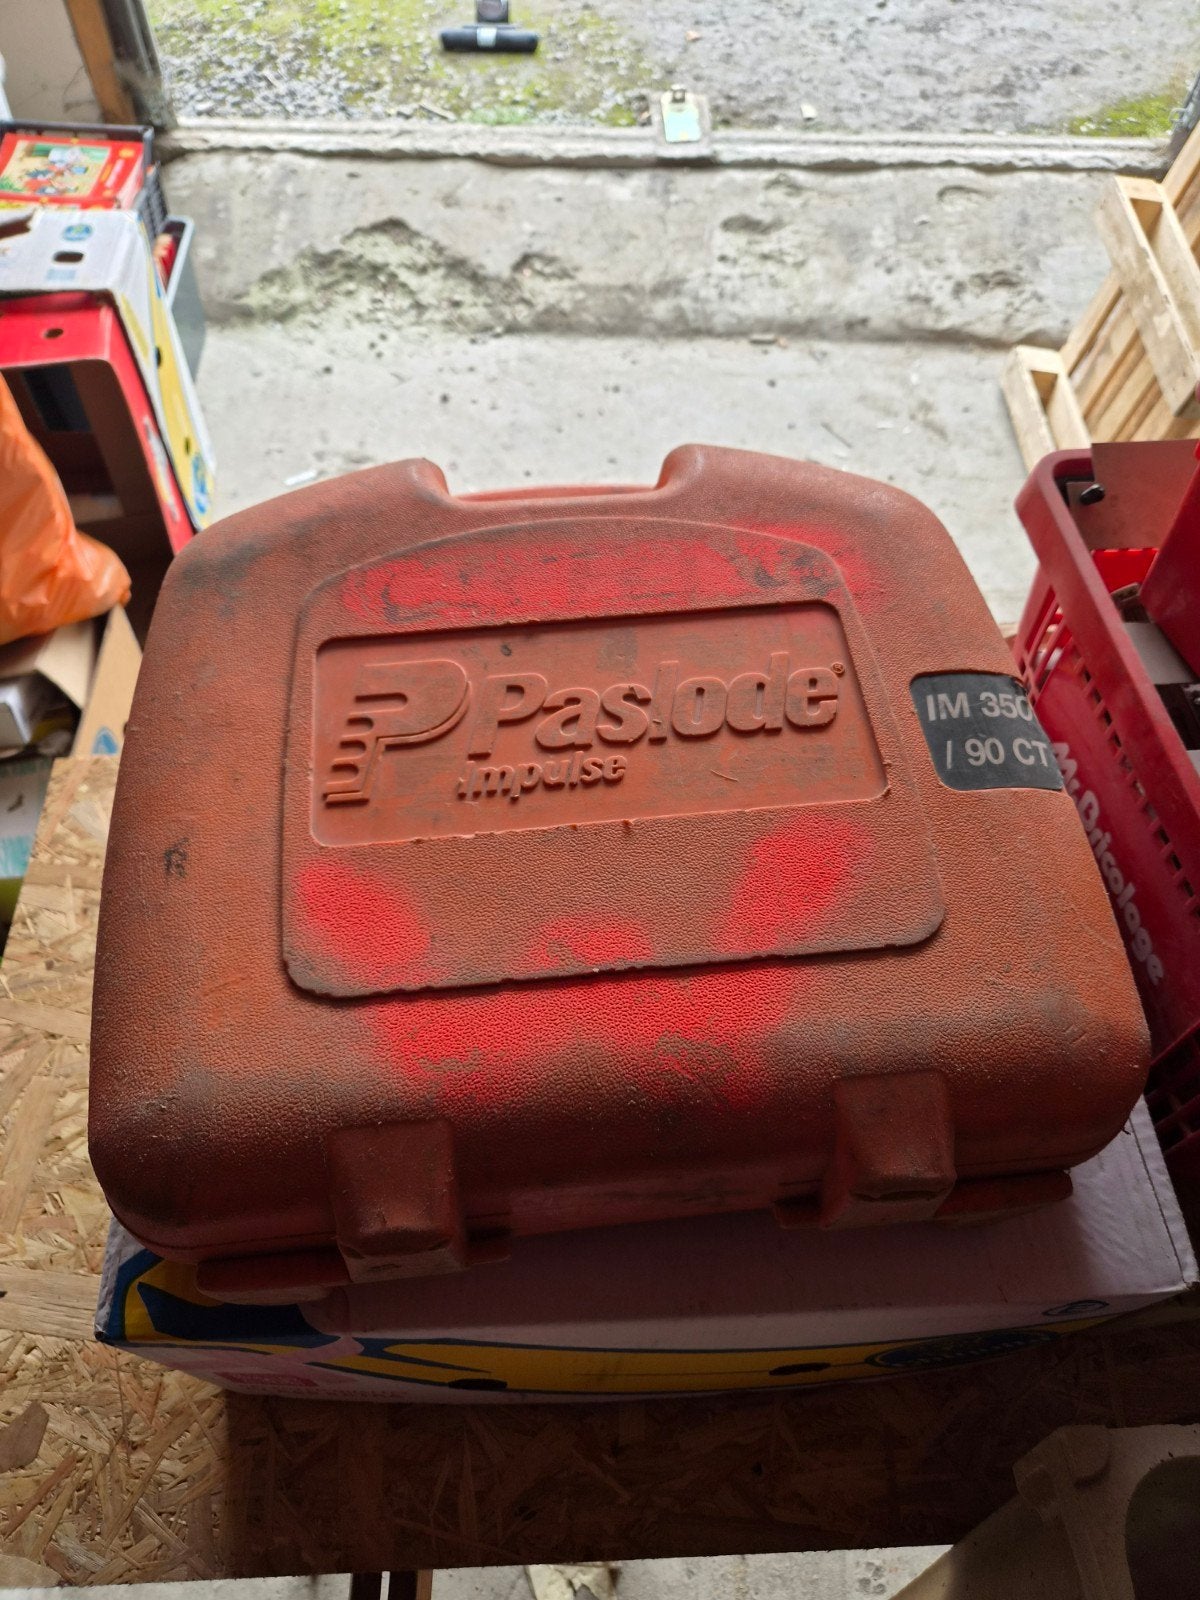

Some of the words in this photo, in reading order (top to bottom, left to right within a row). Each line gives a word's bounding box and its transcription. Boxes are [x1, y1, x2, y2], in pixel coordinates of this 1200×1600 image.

[926, 692, 970, 721] IM
[979, 692, 1032, 720] 350
[964, 738, 1004, 766] 90
[1012, 738, 1049, 767] CT
